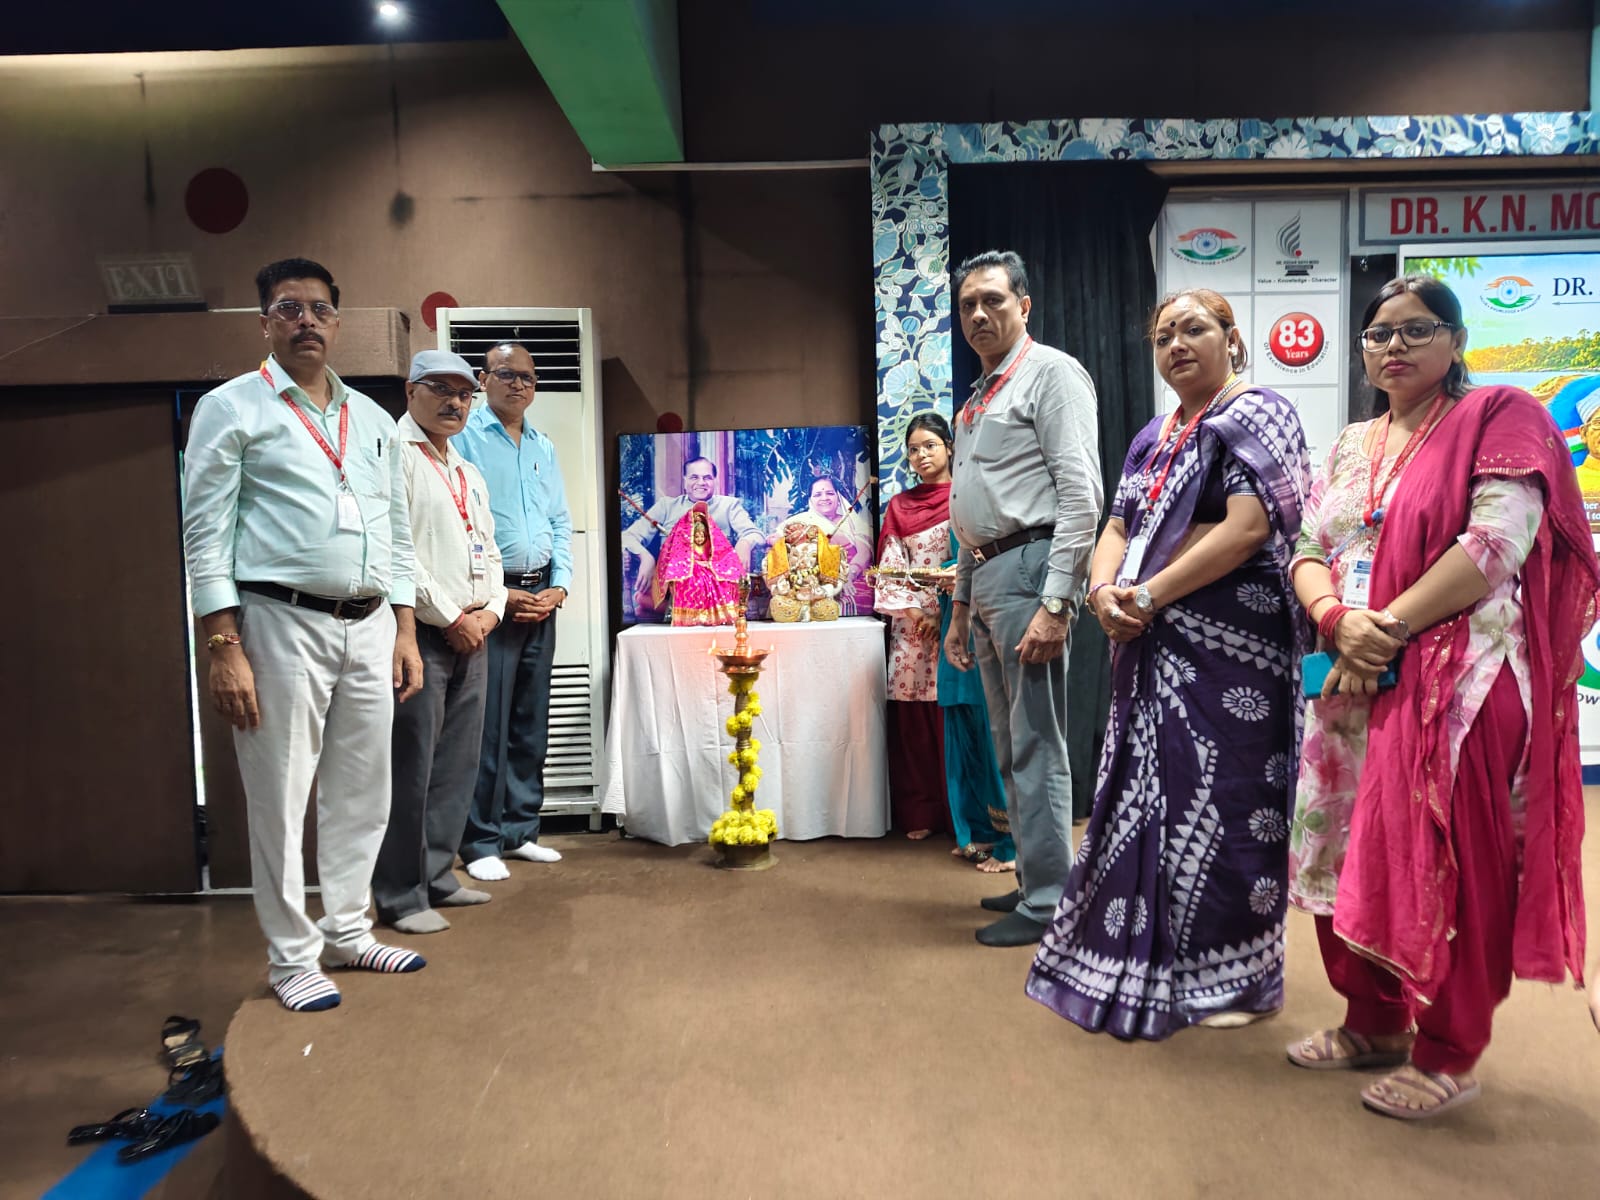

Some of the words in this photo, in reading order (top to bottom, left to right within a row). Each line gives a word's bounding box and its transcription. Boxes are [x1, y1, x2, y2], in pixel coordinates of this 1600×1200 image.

[1391, 197, 1449, 235] DR.
[1463, 195, 1536, 233] K.N.
[106, 264, 195, 298] EXIT
[1552, 277, 1593, 297] DR.
[1279, 319, 1315, 348] 83
[1285, 349, 1309, 359] Years
